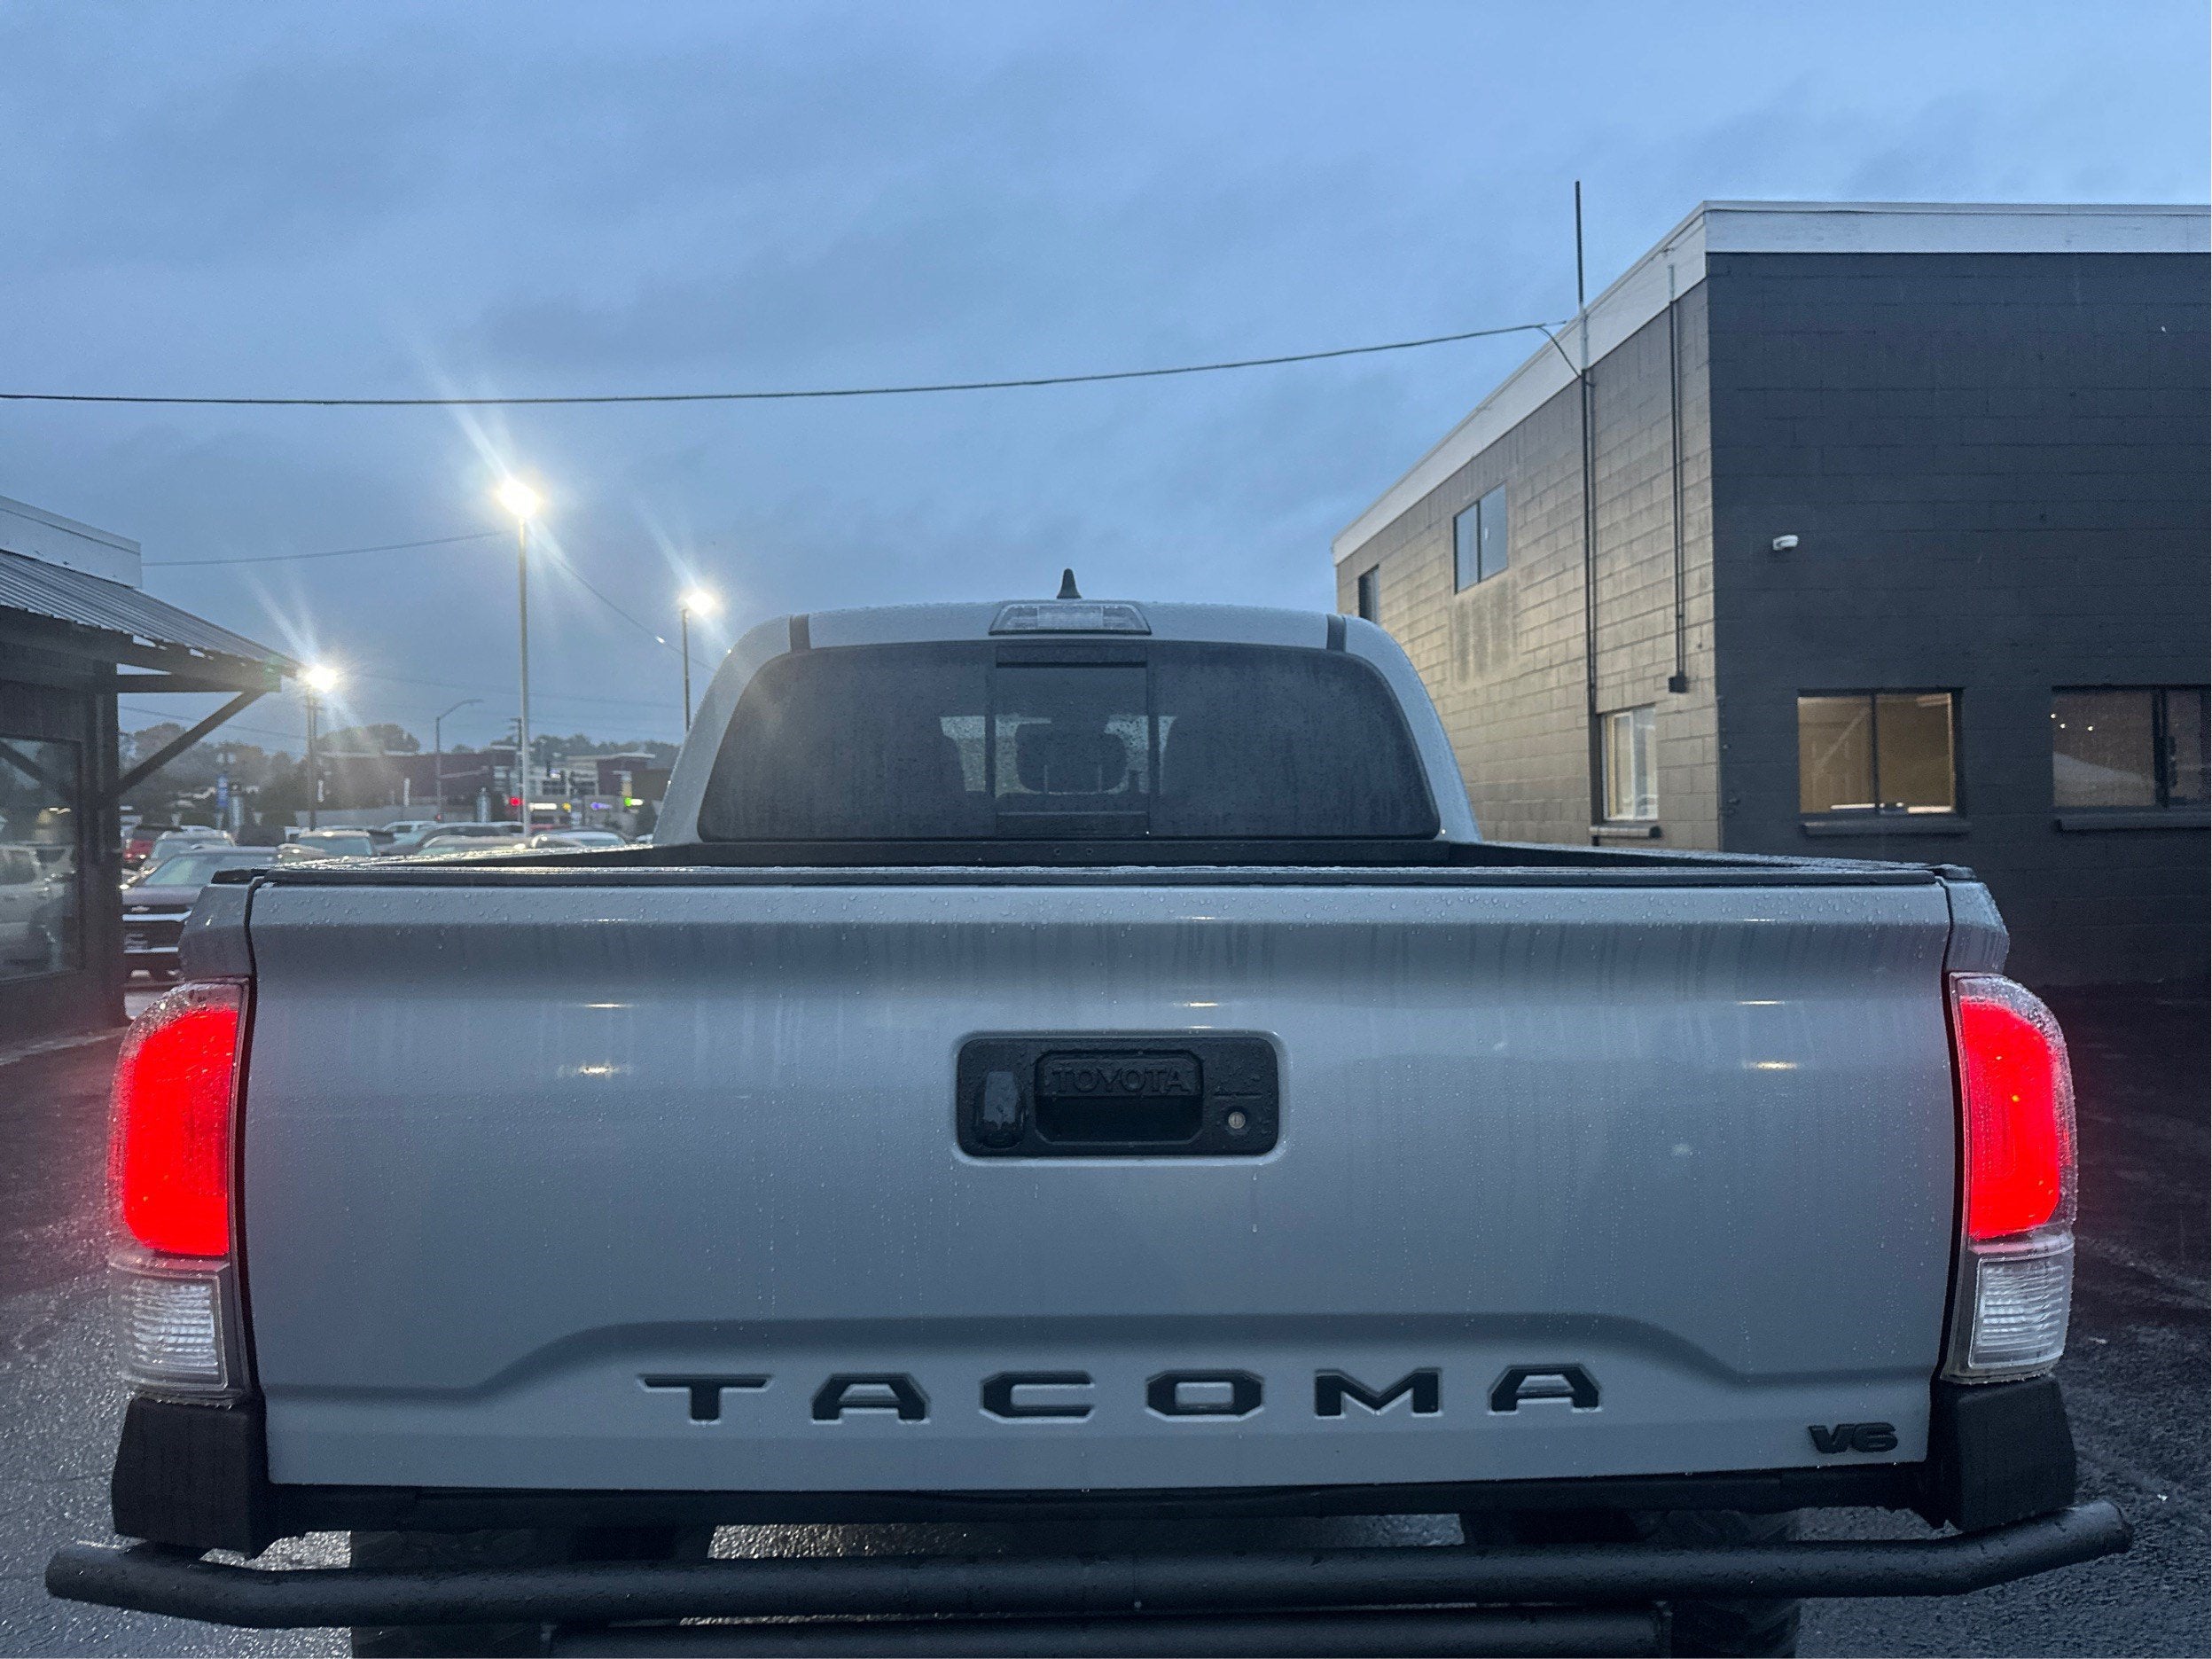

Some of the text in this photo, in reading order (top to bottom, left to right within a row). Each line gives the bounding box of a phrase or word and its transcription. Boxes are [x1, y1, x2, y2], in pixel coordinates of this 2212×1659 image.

[1051, 1067, 1190, 1093] TOYOTA
[637, 1363, 1602, 1424] TACOMA
[1808, 1422, 1898, 1454] V6
